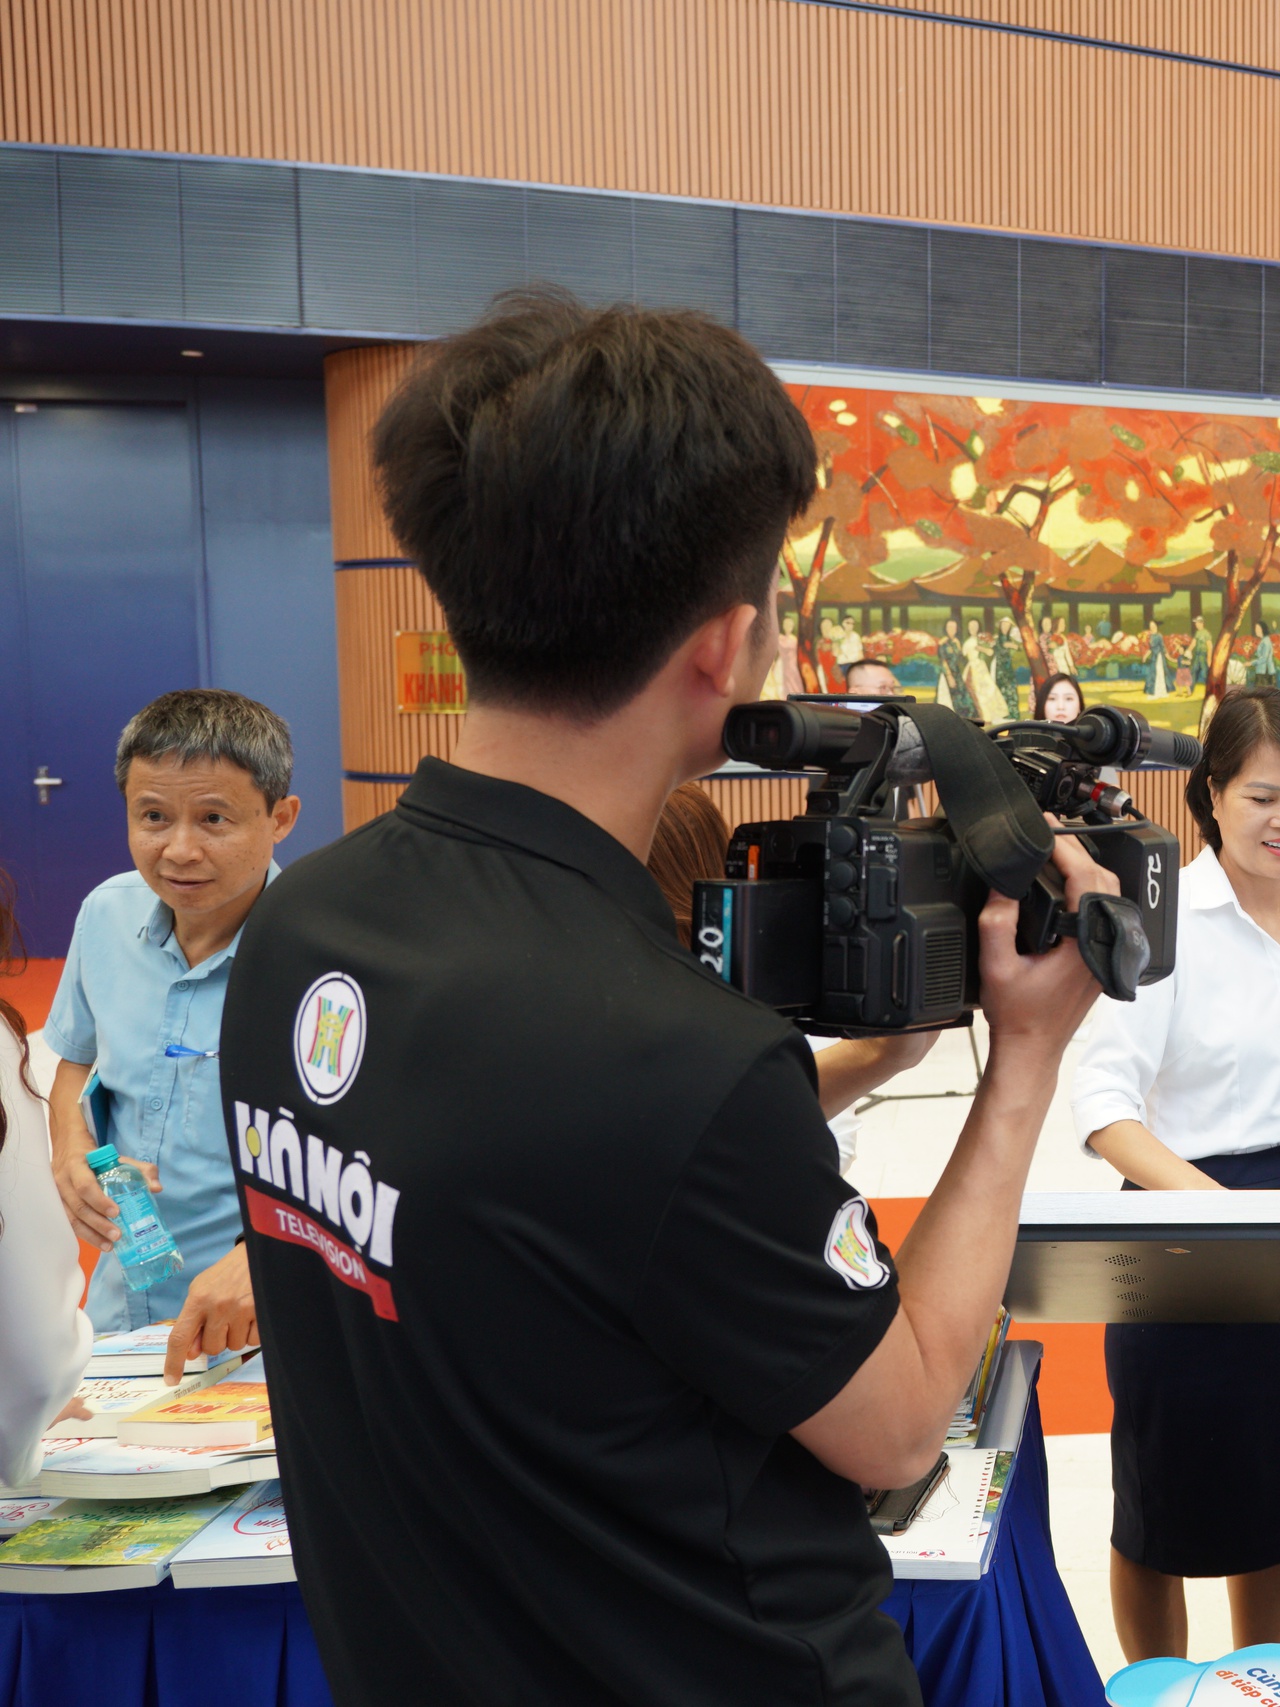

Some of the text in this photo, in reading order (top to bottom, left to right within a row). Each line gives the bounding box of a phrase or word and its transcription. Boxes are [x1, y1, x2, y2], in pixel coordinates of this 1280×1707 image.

[403, 666, 465, 705] KHÁNH
[1146, 852, 1162, 910] 20
[275, 1208, 367, 1285] TELEVISION
[1215, 1669, 1239, 1680] đi
[1230, 1678, 1263, 1699] tiếp
